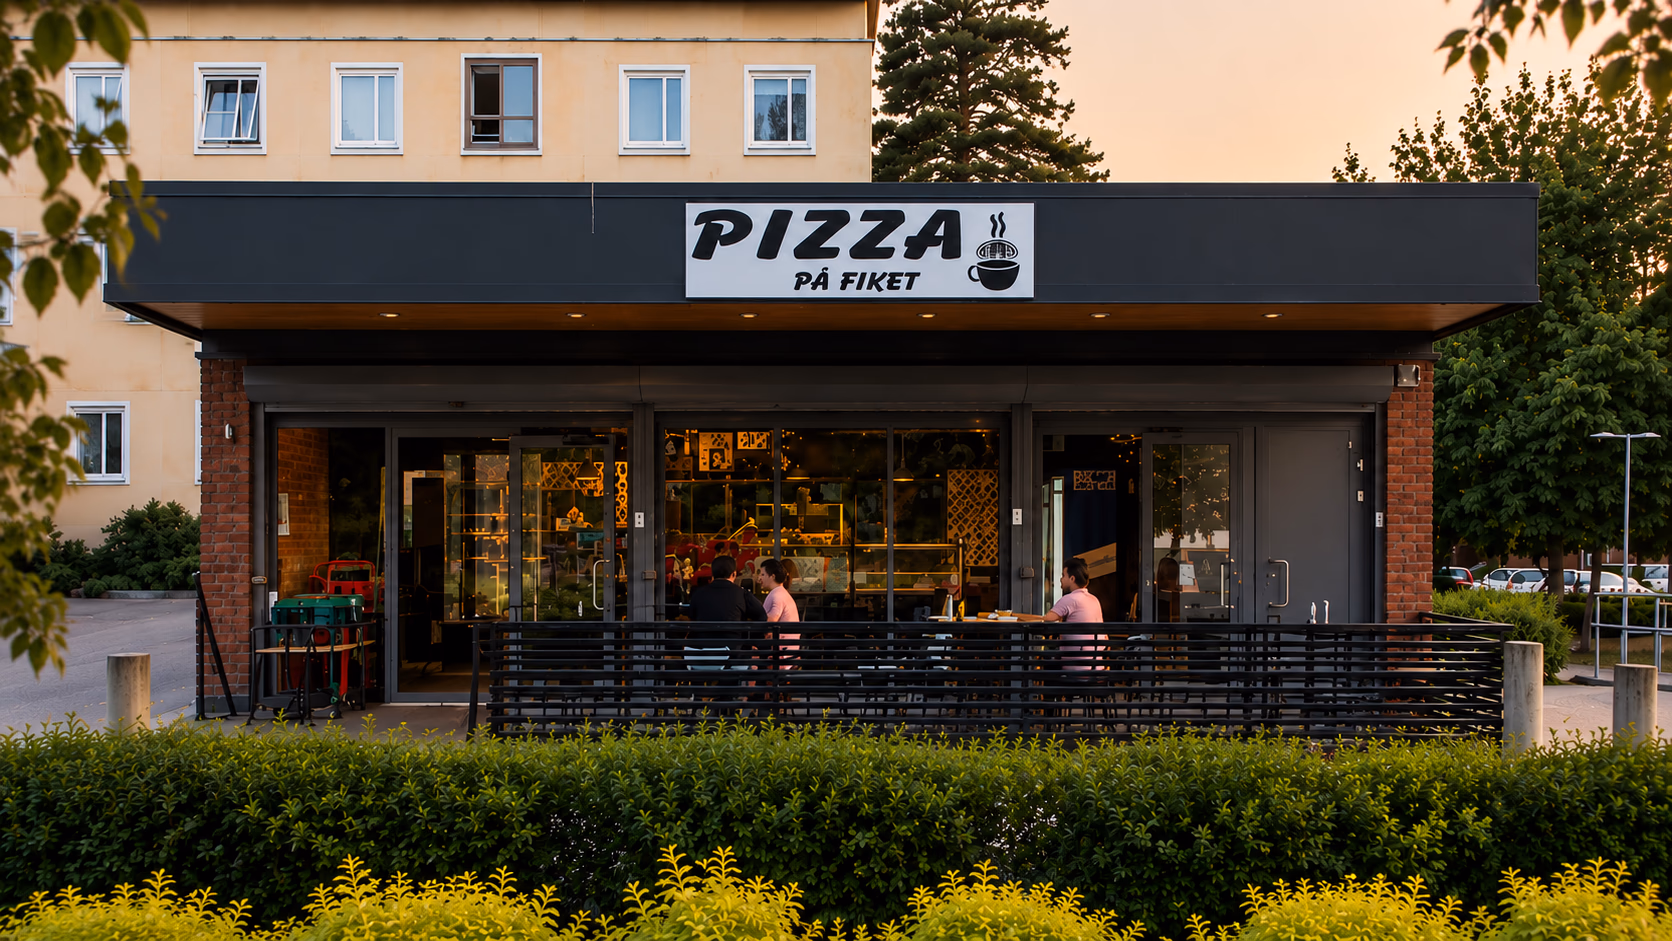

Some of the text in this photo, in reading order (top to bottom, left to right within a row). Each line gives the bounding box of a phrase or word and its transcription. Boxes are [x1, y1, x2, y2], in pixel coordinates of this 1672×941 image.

[691, 208, 962, 260] PIZZA
[793, 266, 921, 293] PÅ FIKET
